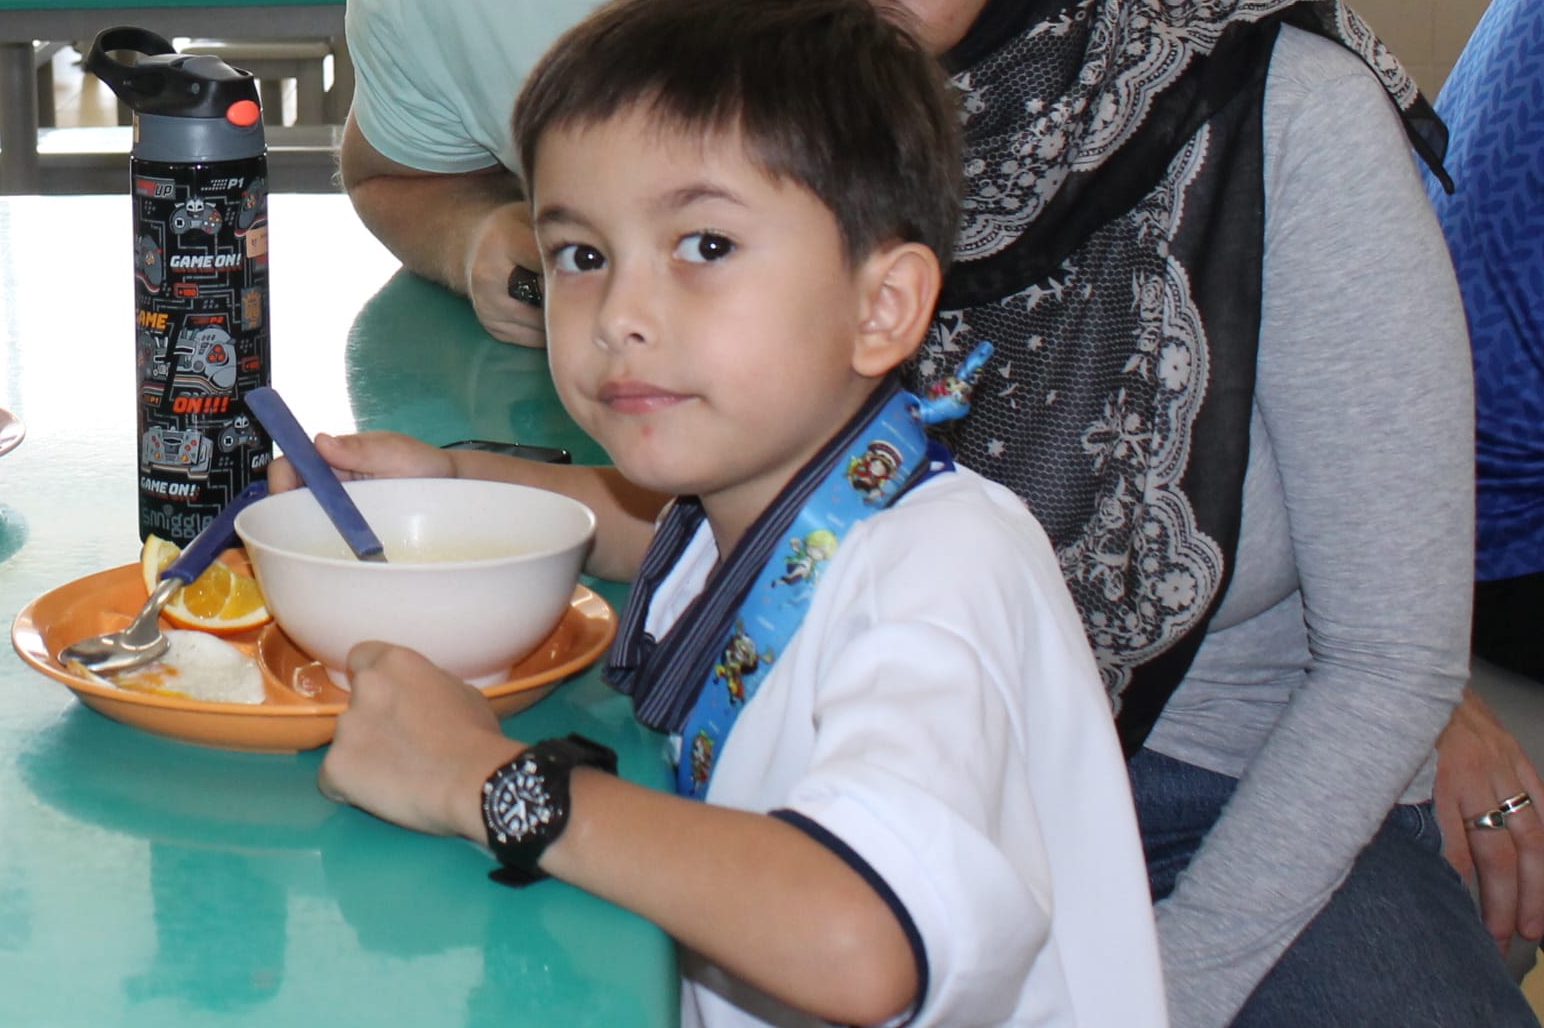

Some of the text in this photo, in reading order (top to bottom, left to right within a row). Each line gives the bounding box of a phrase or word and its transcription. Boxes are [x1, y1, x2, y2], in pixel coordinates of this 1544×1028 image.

[227, 177, 244, 190] P1
[170, 253, 242, 268] GAME ON!
[137, 309, 169, 330] AME
[172, 396, 231, 414] ON!!!
[140, 475, 198, 497] GAME ON!
